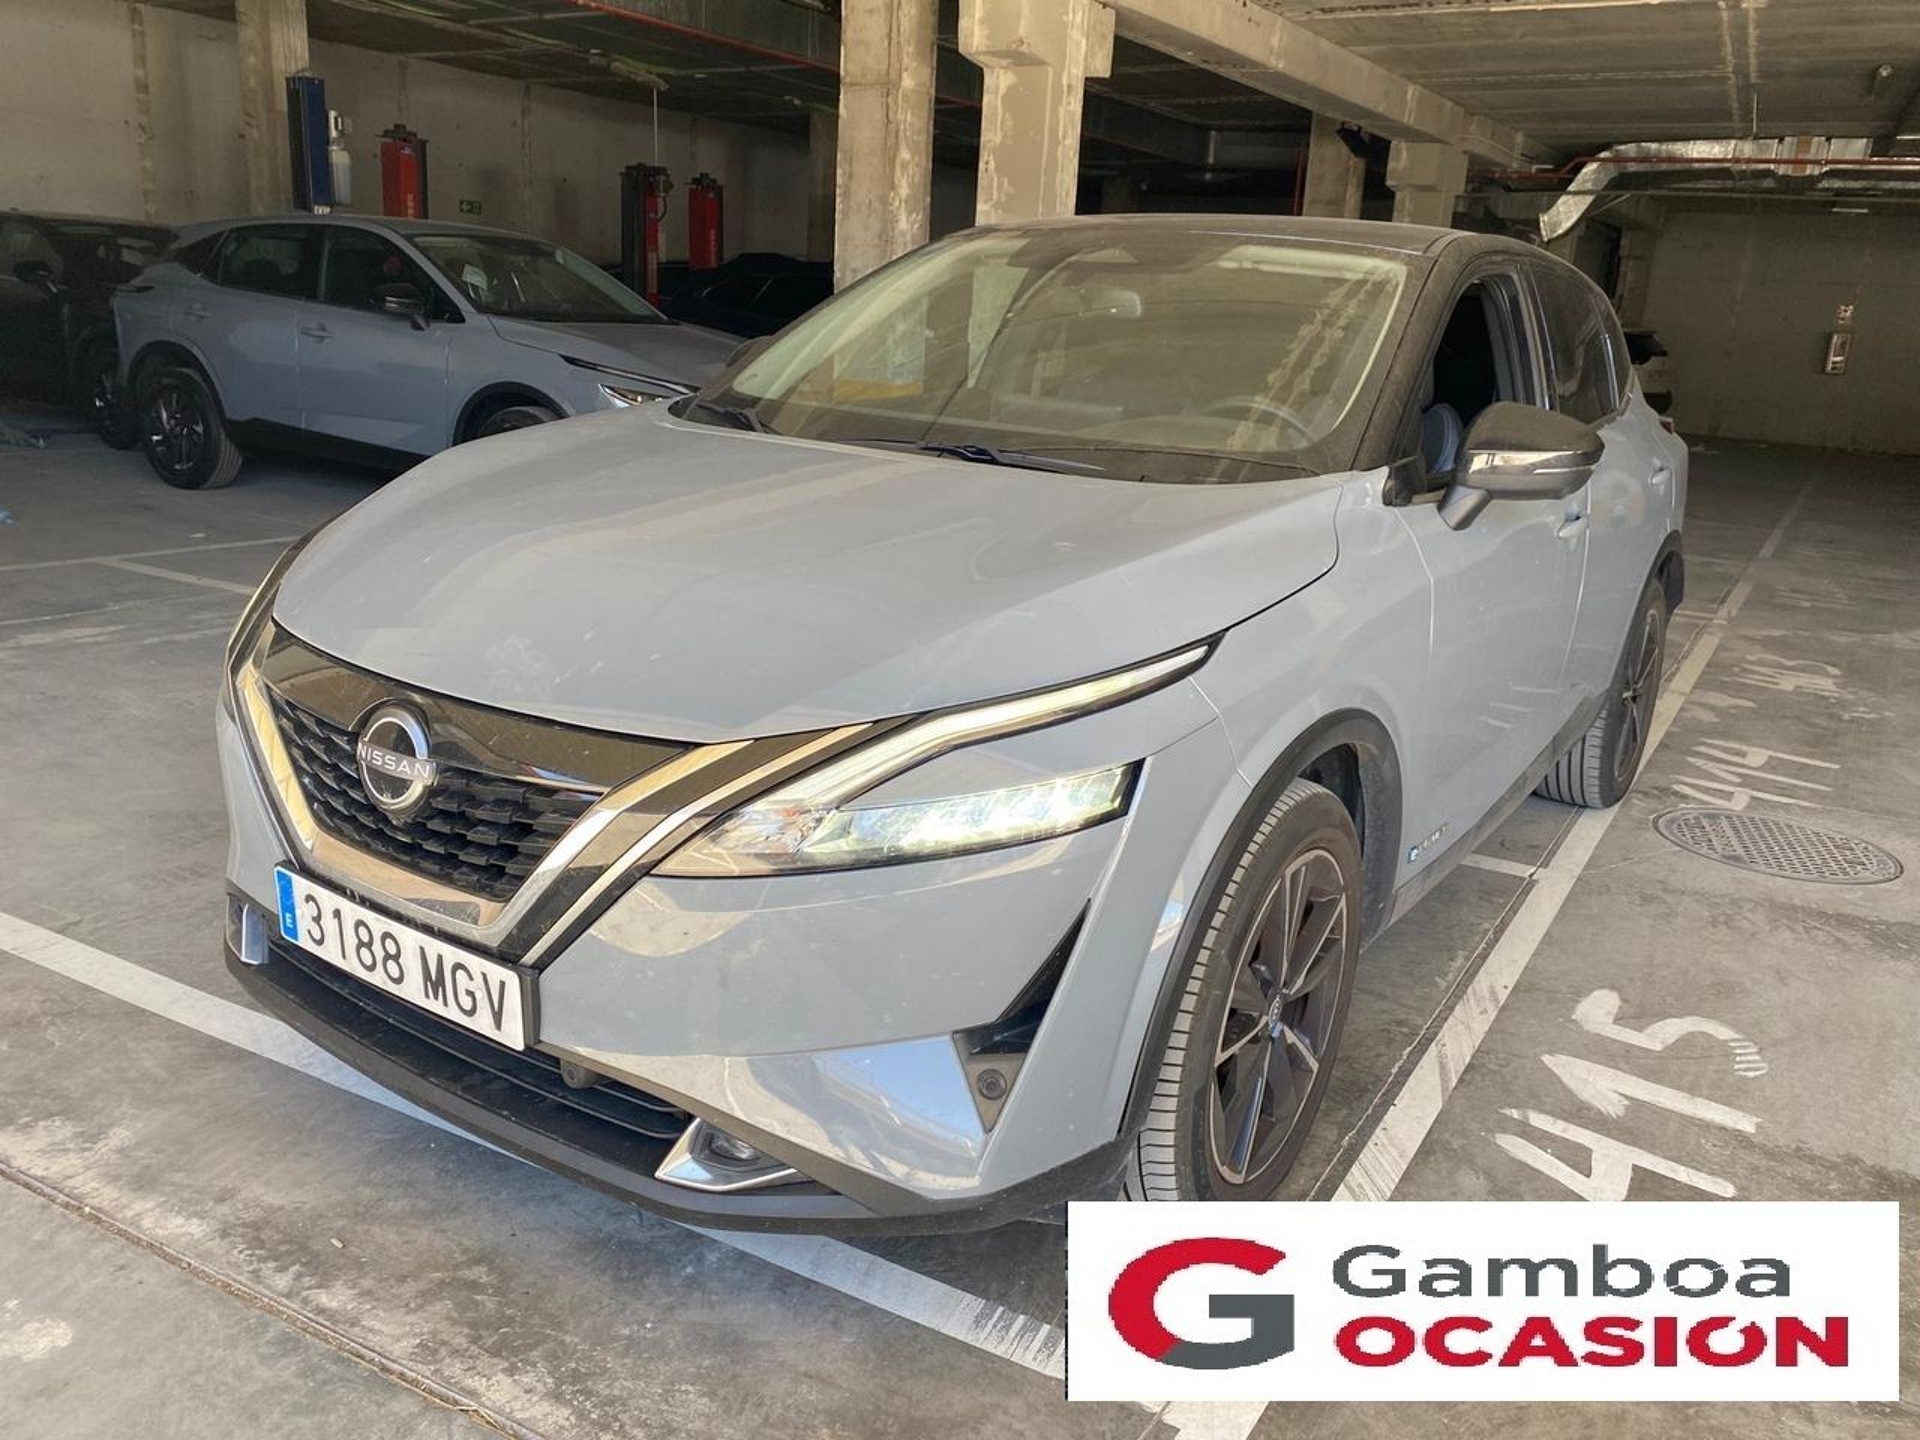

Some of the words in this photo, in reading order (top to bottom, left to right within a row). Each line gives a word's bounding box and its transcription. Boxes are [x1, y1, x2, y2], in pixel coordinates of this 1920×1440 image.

[358, 742, 431, 779] NISSAN
[1670, 737, 1841, 810] 414
[285, 913, 293, 928] E
[304, 893, 405, 986] 3188
[419, 945, 506, 1033] MGV
[1490, 988, 1768, 1201] 415
